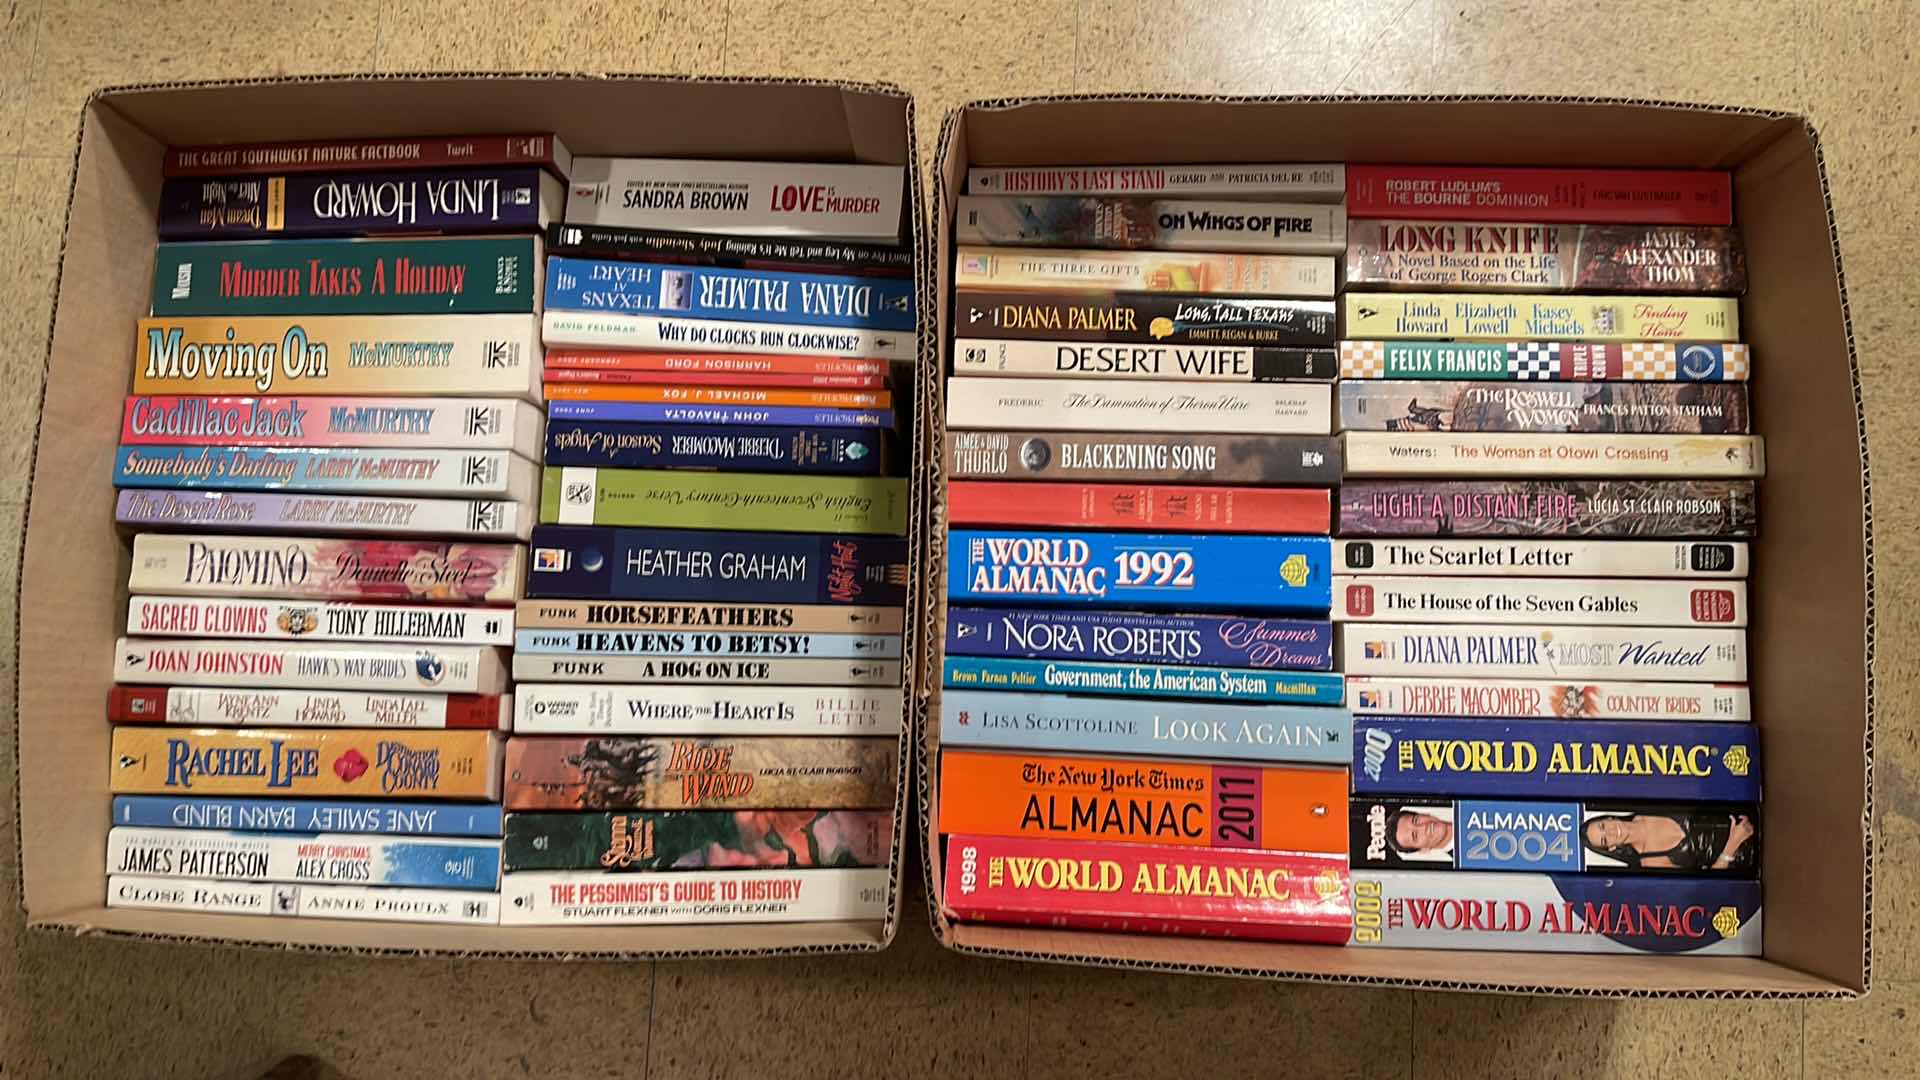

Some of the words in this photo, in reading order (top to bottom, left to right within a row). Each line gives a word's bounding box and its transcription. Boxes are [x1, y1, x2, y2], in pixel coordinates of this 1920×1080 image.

[313, 180, 417, 224] HOWARD
[426, 179, 501, 221] LINDA
[622, 189, 685, 210] SANDRA
[690, 191, 749, 210] BROWN
[770, 185, 826, 212] LOVE
[825, 196, 880, 214] MURDER
[1385, 192, 1410, 205] THE
[1413, 192, 1471, 206] BOURNE
[1475, 193, 1549, 207] DOMINION
[1158, 213, 1186, 229] ON
[1187, 213, 1244, 232] WINGS
[1246, 216, 1273, 231] OF
[1275, 217, 1313, 238] FIRE
[645, 236, 695, 251] Sheindlin
[699, 238, 722, 252] Judy
[1379, 225, 1457, 253] LONG
[1464, 226, 1561, 254] KNIFE
[1384, 255, 1395, 267] A
[1397, 254, 1436, 267] Novel
[1439, 255, 1479, 268] Based
[1482, 258, 1501, 268] on
[1504, 255, 1527, 269] the
[1529, 256, 1556, 269] Life
[1389, 268, 1406, 281] of
[1408, 269, 1457, 284] George
[1460, 270, 1508, 284] Rogers
[1511, 270, 1549, 284] Clark
[699, 274, 789, 313] PALMER
[800, 282, 871, 317] DIANA
[1003, 304, 1062, 330] DIANA
[1067, 306, 1138, 332] PALMER
[1402, 301, 1441, 318] Linda
[1455, 301, 1517, 320] Elizabeth
[657, 321, 688, 341] WHY
[690, 324, 707, 342] DO
[709, 326, 757, 346] CLOCKS
[760, 329, 784, 347] RUN
[788, 331, 860, 352] CLOCKWISE?
[1394, 317, 1449, 334] Howard
[1464, 318, 1509, 335] Lowell
[145, 325, 278, 393] Moving
[280, 325, 329, 380] On
[1055, 346, 1168, 372] DESERT
[1178, 348, 1250, 375] WIFE
[1390, 349, 1434, 372] FELIX
[1437, 349, 1503, 373] FRANCIS
[130, 398, 239, 439] Cadillac
[241, 399, 306, 438] Jack
[672, 436, 736, 459] MACOMBER
[737, 438, 785, 459] DEBBIE
[1060, 444, 1168, 470] BLACKENING
[1170, 446, 1217, 470] SONG
[1450, 444, 1479, 459] The
[1482, 445, 1536, 459] Woman
[1538, 446, 1553, 459] at
[1556, 446, 1599, 460] Otowi
[1604, 447, 1669, 464] Crossing
[955, 451, 1009, 474] THURLO
[1371, 493, 1427, 519] LIGHT
[1431, 493, 1445, 519] A
[1454, 493, 1529, 519] DISTANT
[1535, 493, 1578, 519] FIRE
[626, 549, 713, 578] HEATHER
[720, 552, 806, 581] GRAHAM
[1114, 550, 1195, 587] 1992
[1384, 545, 1432, 566] The
[1433, 545, 1505, 566] Scarlet
[1509, 546, 1574, 567] Letter
[971, 566, 1107, 596] ALMANAC
[1383, 592, 1417, 610] The
[1420, 593, 1473, 610] House
[1475, 592, 1490, 611] of
[1492, 593, 1522, 612] the
[1525, 596, 1575, 613] Seven
[1578, 596, 1639, 615] Gables
[140, 604, 200, 633] SACRED
[203, 605, 268, 634] CLOWNS
[326, 608, 368, 636] TONY
[372, 609, 467, 639] HILLERMAN
[586, 605, 794, 628] HORSEFEATHERS
[575, 632, 685, 652] HEAVENS
[689, 633, 722, 652] TO
[728, 634, 810, 655] BETSY!
[1003, 616, 1083, 653] NORA
[1092, 625, 1201, 656] ROBERTS
[146, 649, 188, 673] JOAN
[194, 651, 285, 676] JOHNSTON
[1402, 635, 1462, 664] DIANA
[1466, 635, 1539, 665] PALMER
[642, 662, 656, 678] A
[659, 662, 702, 678] HOG
[706, 662, 732, 678] ON
[737, 662, 770, 679] ICE
[1043, 662, 1127, 689] Government,
[1128, 670, 1151, 689] the
[1154, 669, 1218, 692] American
[1219, 673, 1267, 695] System
[815, 697, 881, 711] BILLIE
[1401, 685, 1457, 713] DEBBIE
[1460, 689, 1541, 715] MACOMBER
[817, 712, 879, 726] LETTS
[981, 711, 1020, 729] LISA
[1025, 714, 1138, 735] SCOTTOLINE
[1151, 714, 1227, 742] LOOK
[1233, 718, 1322, 747] AGAIN
[164, 738, 265, 788] RACHEL
[267, 741, 319, 788] LEE
[1364, 727, 1393, 783] 2000
[1398, 740, 1415, 771] THE
[1415, 740, 1539, 773] WORLD
[1547, 744, 1714, 777] ALMANAC
[1022, 762, 1057, 784] The
[1058, 766, 1097, 786] New
[1100, 766, 1145, 792] York
[1148, 769, 1205, 791] Times
[171, 804, 233, 824] BLIND
[239, 805, 296, 828] BARN
[306, 806, 382, 830] SMILEY
[386, 808, 438, 832] JANE
[1020, 793, 1205, 838] ALMANAC
[1218, 775, 1256, 841] 2011
[1467, 812, 1573, 833] ALMANAC
[297, 844, 326, 859] MERRY
[327, 846, 371, 860] CHRISTMAS
[1465, 832, 1574, 863] 2004
[118, 849, 174, 874] JAMES
[179, 852, 271, 878] PATTERSON
[296, 859, 328, 879] ALEX
[330, 861, 370, 881] CROSS
[961, 846, 977, 895] 1998
[989, 855, 1005, 887] THE
[1005, 856, 1124, 893] WORLD
[1131, 863, 1291, 900] ALMANAC
[119, 884, 186, 902] CLOSE
[192, 888, 262, 907] RANGE
[308, 896, 365, 911] ANNIE
[374, 899, 449, 915] PROULX
[549, 883, 576, 905] THE
[579, 882, 669, 904] PESSIMIST'S
[673, 881, 715, 902] GUIDE
[719, 881, 737, 901] TO
[740, 880, 802, 901] HISTORY
[563, 907, 613, 918] STUART
[614, 906, 669, 917] FLEXNER
[693, 904, 730, 915] DORIS
[732, 903, 787, 914] FLEXNER
[1354, 880, 1383, 943] 2002
[1387, 896, 1403, 928] THE
[1403, 897, 1532, 932] WORLD
[1538, 902, 1708, 938] ALMANAC
